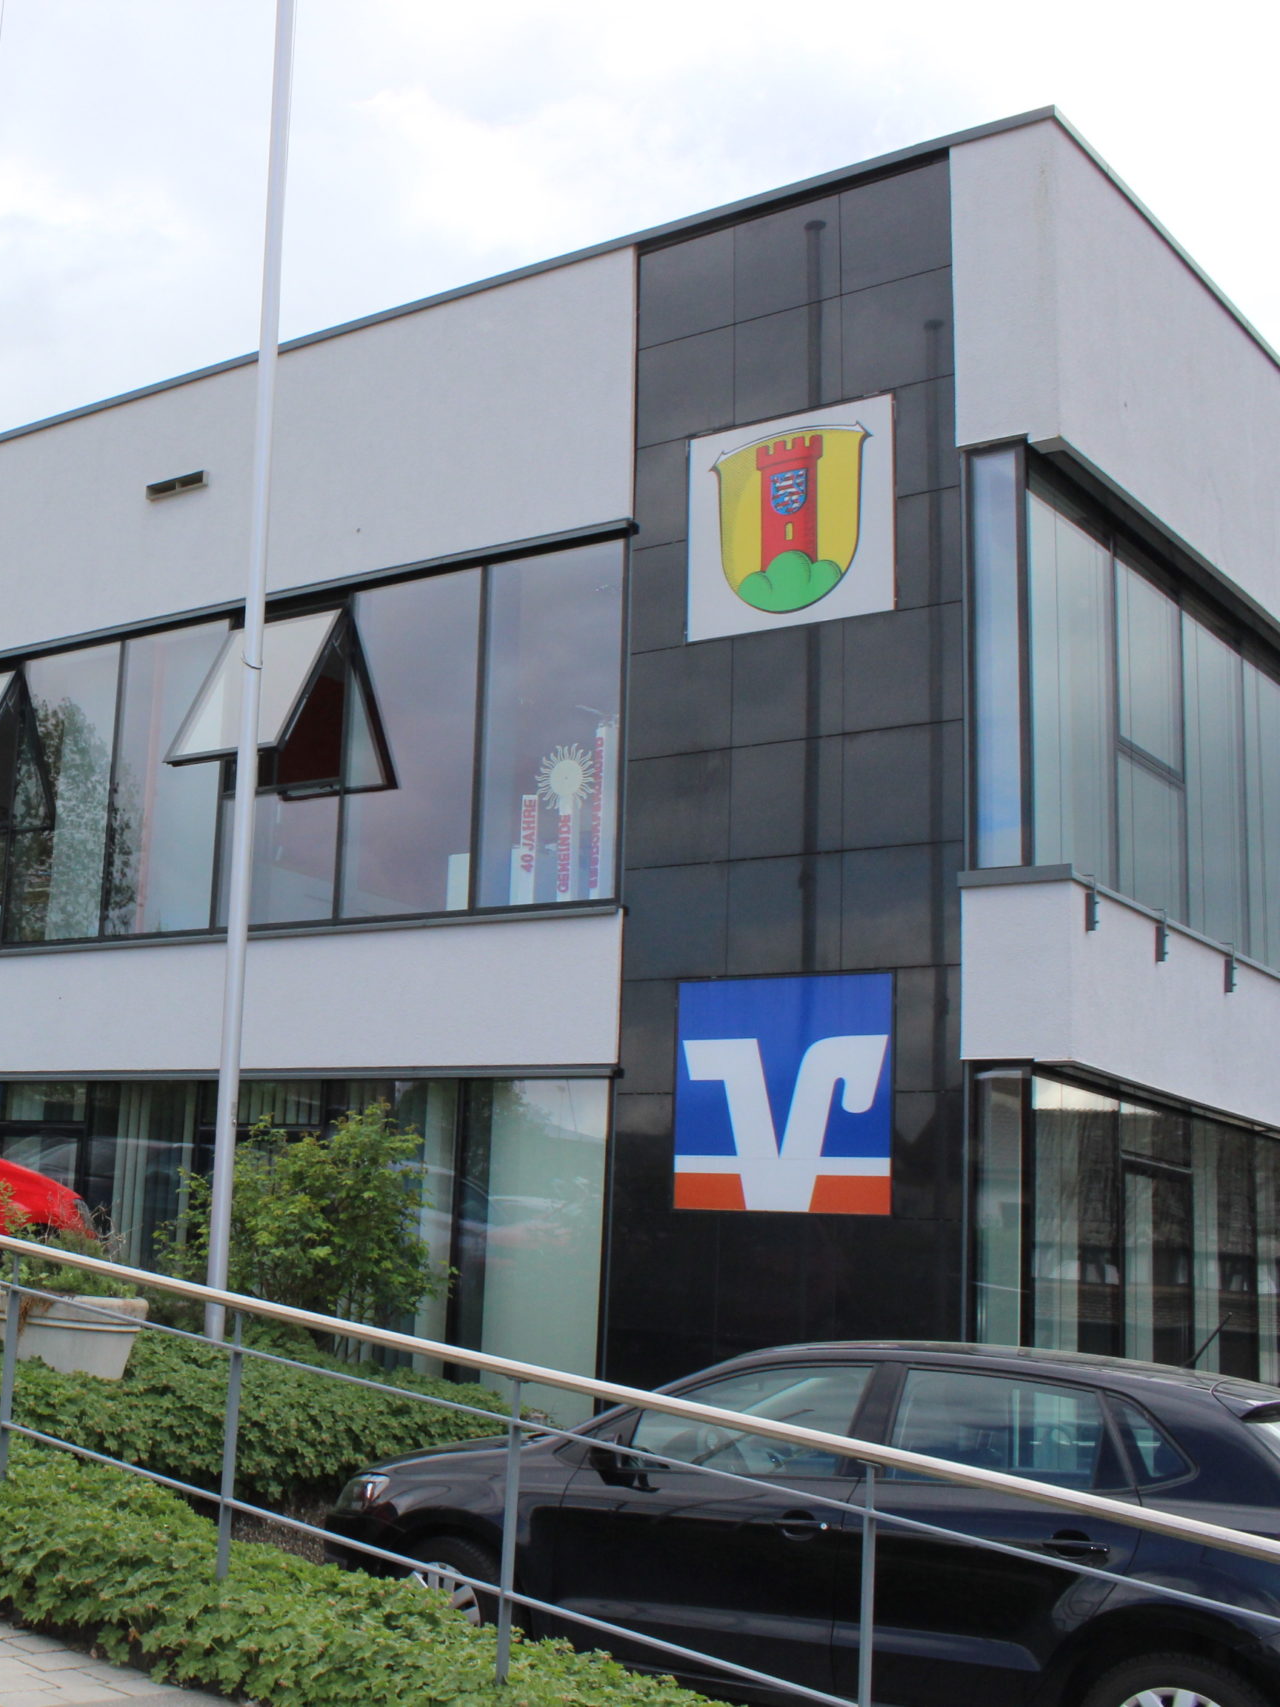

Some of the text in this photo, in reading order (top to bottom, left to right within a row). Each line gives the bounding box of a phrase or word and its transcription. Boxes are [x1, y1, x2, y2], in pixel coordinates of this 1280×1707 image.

[521, 799, 537, 873] 40 JAHRE
[557, 814, 571, 893] GEMEINDE
